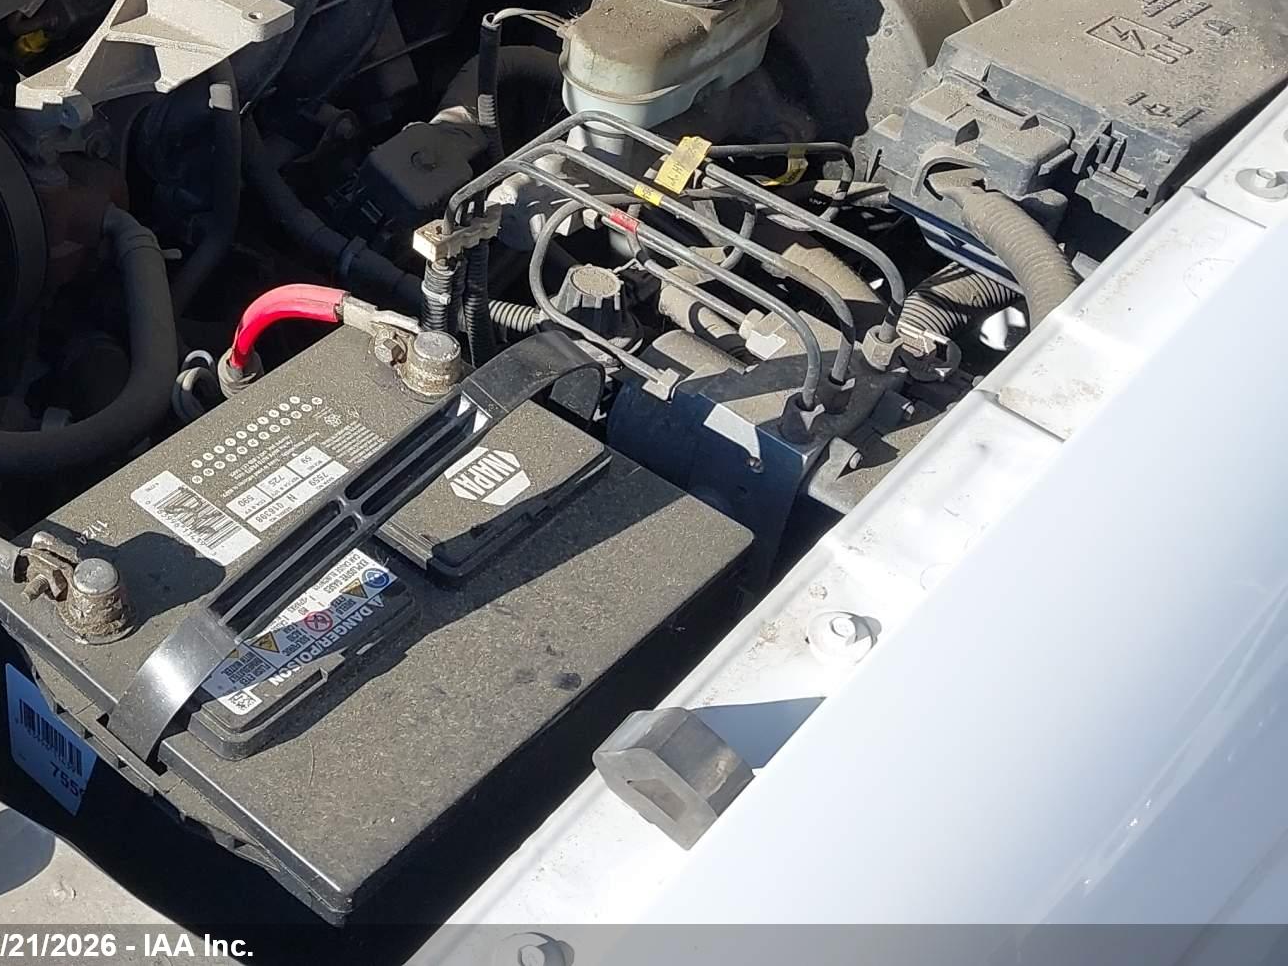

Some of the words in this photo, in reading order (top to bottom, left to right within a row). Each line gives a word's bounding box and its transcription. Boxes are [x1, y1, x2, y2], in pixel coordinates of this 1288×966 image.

[298, 454, 314, 465] 59
[266, 473, 286, 487] 725
[306, 470, 330, 487] 7559
[453, 452, 517, 497] NAPA
[235, 493, 256, 508] 590
[266, 604, 374, 686] DANGER/POISON
